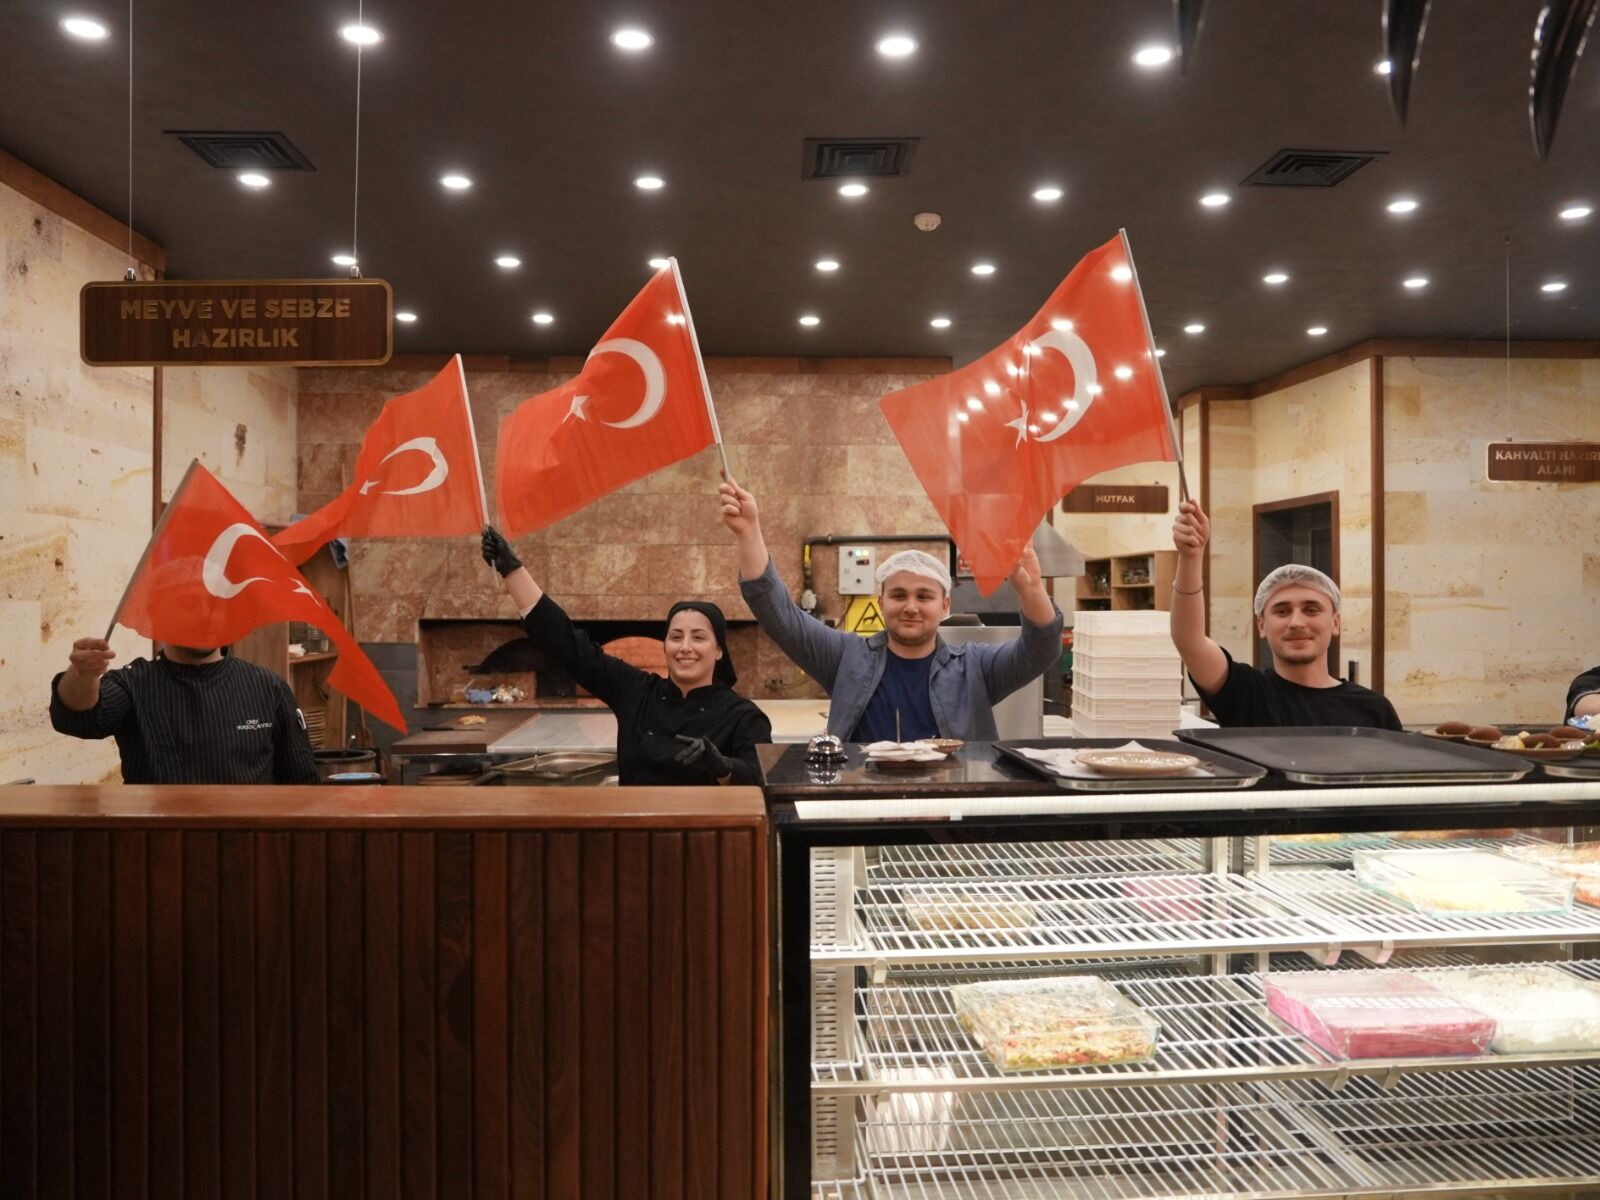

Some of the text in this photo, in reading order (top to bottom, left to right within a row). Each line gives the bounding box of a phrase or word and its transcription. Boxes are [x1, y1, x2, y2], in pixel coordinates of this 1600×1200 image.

[120, 297, 350, 320] MEYVE VE SEBZE
[173, 328, 299, 349] HAZIRLIK
[1495, 450, 1556, 461] KAHVALTI
[1536, 464, 1576, 475] ALANI
[1095, 495, 1135, 503] MUTFAK
